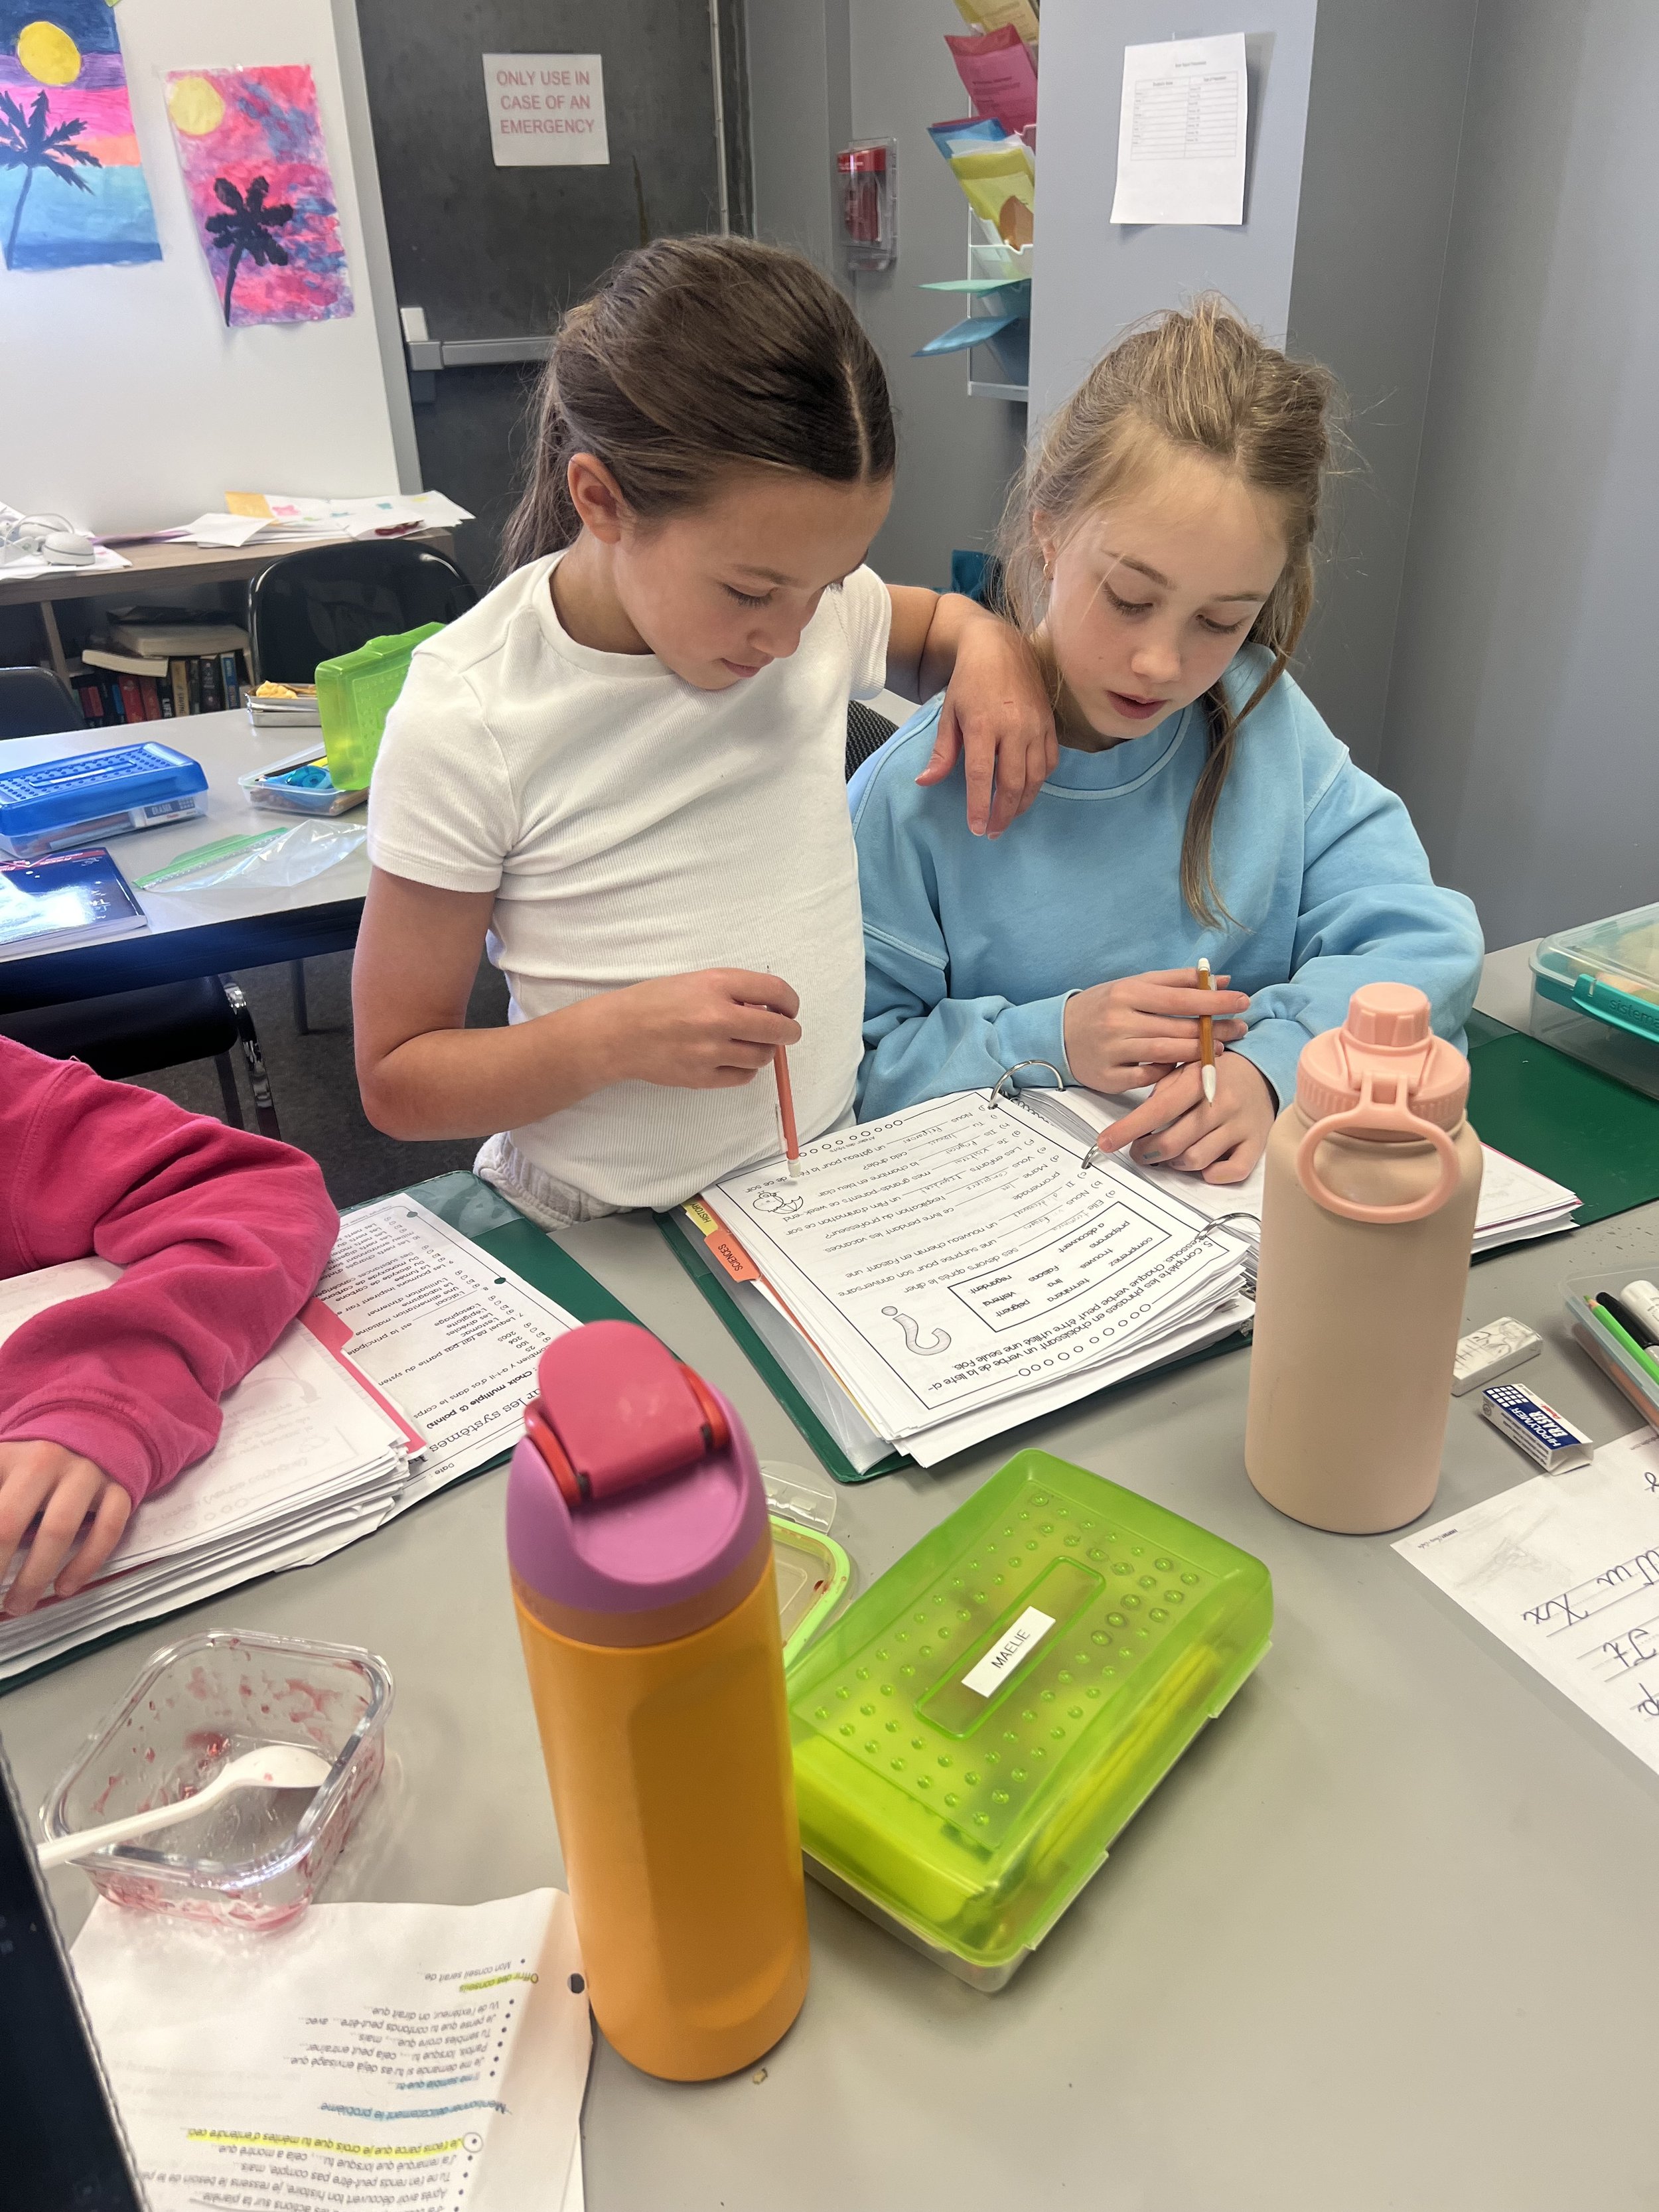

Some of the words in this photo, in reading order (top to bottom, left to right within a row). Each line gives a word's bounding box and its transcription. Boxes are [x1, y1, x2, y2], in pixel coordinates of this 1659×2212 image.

[496, 71, 536, 86] ONLY
[541, 71, 569, 86] USE
[575, 71, 589, 86] IN
[501, 96, 541, 110] CASE
[545, 96, 565, 109] OF
[570, 96, 590, 109] AN
[500, 119, 594, 133] EMERGENCY
[950, 1112, 974, 1123] Nous
[842, 1148, 873, 1161] gâteau
[889, 1151, 908, 1160] cela
[1004, 1146, 1023, 1157] Les
[822, 1158, 843, 1169] pour
[863, 1157, 889, 1171] drôle?
[969, 1155, 1003, 1172] enfants
[1011, 1155, 1036, 1168] Vous
[869, 1165, 908, 1181] chambre
[911, 1171, 931, 1181] mes
[1022, 1163, 1048, 1179] Marie
[841, 1177, 910, 1203] grands-parents
[1066, 1189, 1090, 1205] Nous
[869, 1200, 889, 1209] film
[895, 1195, 946, 1216] l'explication
[1087, 1199, 1105, 1211] Elle
[691, 1203, 711, 1223] HISTORY
[817, 1207, 869, 1225] d'animation
[922, 1212, 944, 1221] livre
[825, 1217, 881, 1239] professeur?
[885, 1218, 922, 1235] pendant
[946, 1227, 986, 1244] nouveau
[1057, 1227, 1098, 1253] découvert
[1089, 1220, 1131, 1249] préparons
[824, 1237, 868, 1253] vacances.
[913, 1242, 946, 1256] chemin
[979, 1239, 997, 1249] une
[1165, 1236, 1204, 1263] essous.
[718, 1244, 743, 1271] SCIENCES
[940, 1247, 979, 1263] surprise
[1001, 1247, 1019, 1257] ses
[1079, 1248, 1114, 1269] trouves
[1108, 1237, 1153, 1267] comprenez
[866, 1258, 901, 1273] faisant
[916, 1260, 940, 1272] pour
[967, 1255, 1000, 1271] devoirs
[1158, 1247, 1203, 1279] Complète
[396, 1269, 432, 1288] poumons
[845, 1270, 864, 1278] une
[896, 1269, 914, 1278] son
[938, 1268, 966, 1281] après
[1028, 1265, 1060, 1282] faisons
[1129, 1264, 1165, 1288] Chaque
[443, 1286, 460, 1295] Une
[970, 1274, 1013, 1295] regardent
[1046, 1278, 1064, 1288] lira
[1046, 1278, 1090, 1303] terminera
[1143, 1278, 1161, 1289] les
[335, 1285, 368, 1302] carbone
[401, 1287, 443, 1307] tabagisme
[435, 1290, 466, 1307] L'alcool
[981, 1291, 1017, 1307] visiterai
[1100, 1288, 1130, 1305] verbe
[1105, 1286, 1145, 1314] phrases
[392, 1294, 442, 1319] alimentation
[995, 1298, 1031, 1317] peignent
[1078, 1303, 1102, 1321] peut
[446, 1307, 488, 1329] L'épiglotte
[488, 1316, 516, 1332] Lequel
[1052, 1318, 1077, 1332] être
[1091, 1313, 1106, 1322] en
[355, 1317, 392, 1336] malsaine
[400, 1322, 413, 1331] est
[445, 1319, 478, 1337] alvéoles
[460, 1317, 500, 1338] L'estomac
[497, 1331, 517, 1343] 2005
[508, 1335, 523, 1345] 206
[1023, 1330, 1053, 1346] utilisé
[1039, 1321, 1092, 1351] choisissant
[516, 1340, 530, 1349] 100
[525, 1345, 536, 1353] 25
[1003, 1342, 1023, 1353] une
[1023, 1347, 1039, 1355] un
[417, 1351, 443, 1366] partie
[975, 1349, 1003, 1363] seule
[992, 1353, 1024, 1366] verbe
[404, 1365, 416, 1374] du
[951, 1359, 976, 1370] fois.
[977, 1363, 992, 1372] de
[470, 1378, 488, 1389] d'os
[506, 1370, 533, 1386] Choix
[942, 1372, 968, 1385] liste
[449, 1388, 470, 1400] dans
[926, 1381, 944, 1392] ci-
[469, 1384, 507, 1406] multiple
[413, 1404, 437, 1419] corps
[502, 1397, 529, 1412] les
[426, 1409, 458, 1430] points)
[1528, 1409, 1568, 1439] ERASER
[429, 1410, 501, 1453] systèmes
[434, 1462, 455, 1475] Date
[1521, 1593, 1589, 1627] Xx
[991, 1629, 1031, 1668] MAELIE
[463, 1966, 494, 1980] conseil
[494, 1960, 512, 1972] Mon
[438, 1970, 463, 1983] serait
[392, 2009, 417, 2022] dirait
[418, 2012, 431, 2022] on
[386, 2022, 429, 2035] confonds
[350, 2045, 376, 2057] peut
[376, 2049, 397, 2061] cela
[310, 2056, 355, 2069] envisagé
